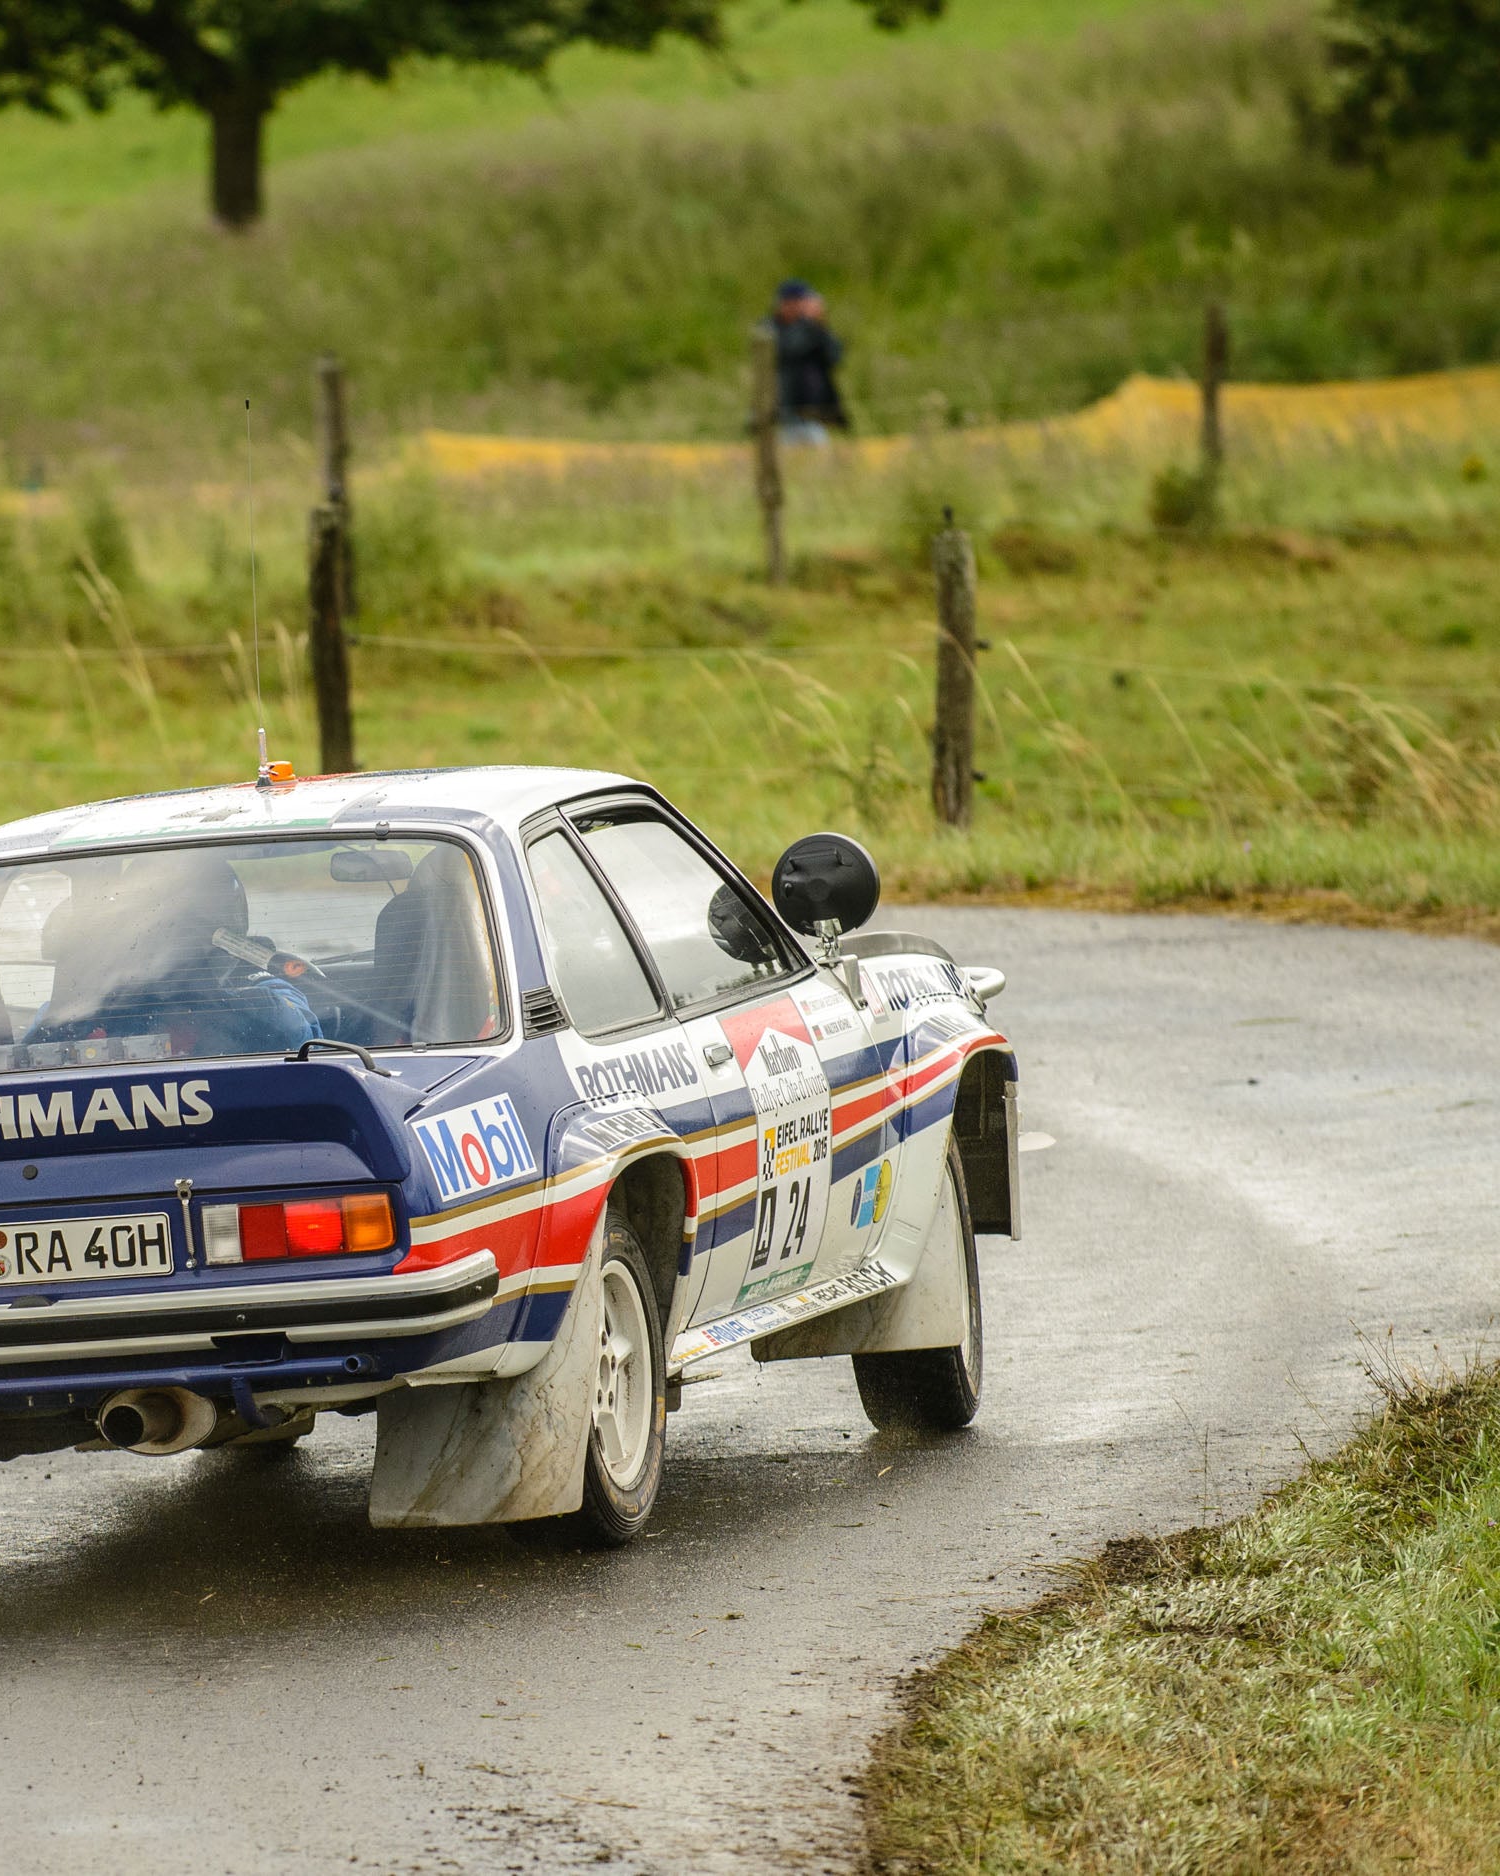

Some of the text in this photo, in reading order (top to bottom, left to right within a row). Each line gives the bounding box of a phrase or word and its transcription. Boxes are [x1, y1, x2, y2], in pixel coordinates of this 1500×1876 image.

[575, 1042, 698, 1108] ROTHMANS
[757, 1034, 802, 1077] Marlboro
[751, 1082, 784, 1117] Rallye
[416, 1098, 534, 1197] Mobil
[777, 1107, 829, 1149] EIFEL RALLYE
[775, 1135, 828, 1177] FESTIVAL 2015
[780, 1176, 811, 1260] 24
[14, 1230, 73, 1275] RA
[83, 1222, 168, 1269] 40H
[835, 1260, 897, 1295] BOSCH
